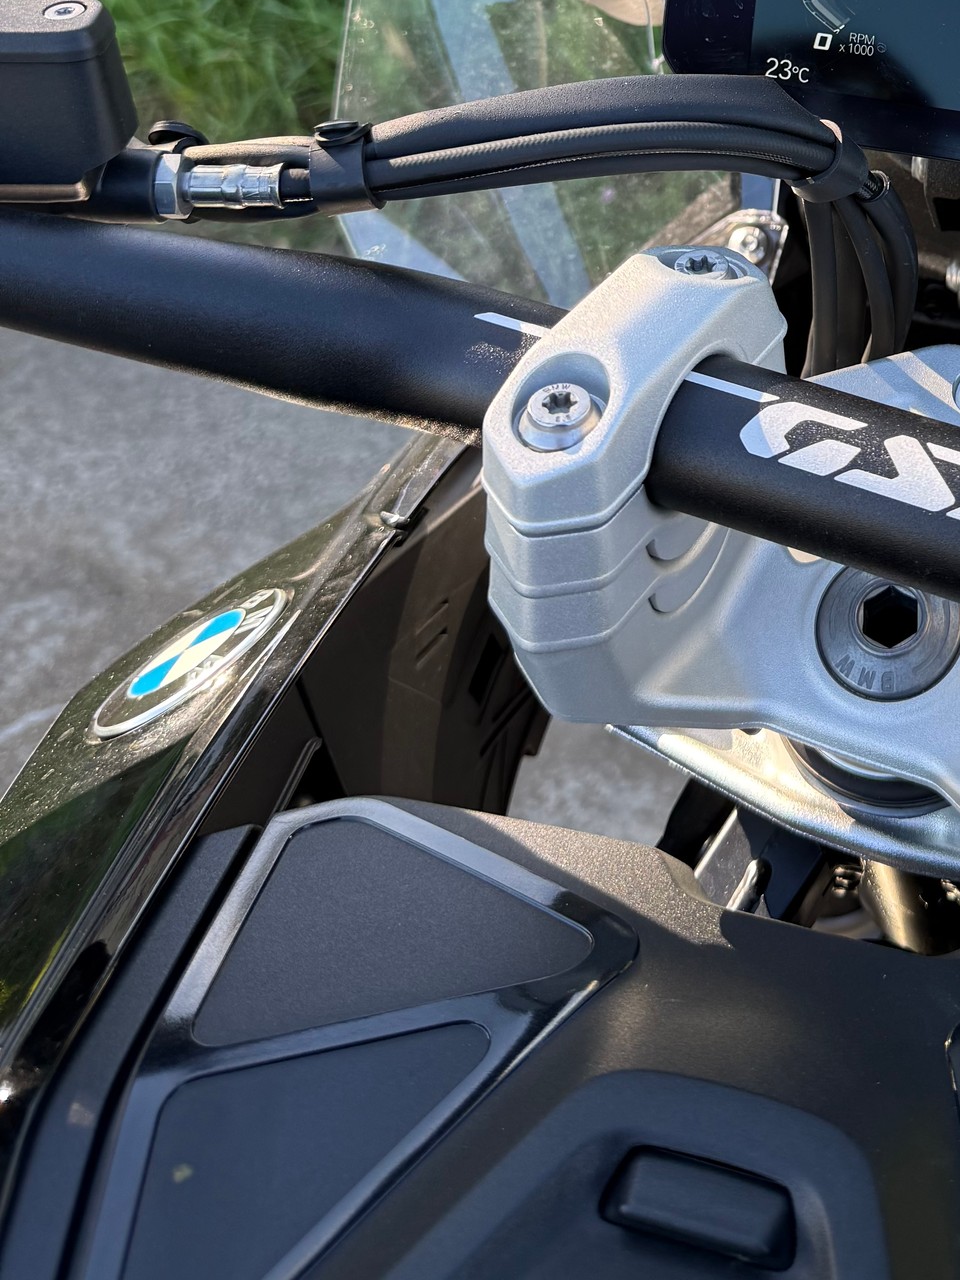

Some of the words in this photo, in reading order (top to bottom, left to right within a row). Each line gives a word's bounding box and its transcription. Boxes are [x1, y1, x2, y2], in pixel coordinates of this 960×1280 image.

[813, 32, 833, 51] 0
[849, 32, 875, 45] RPM
[834, 653, 896, 693] BMW
